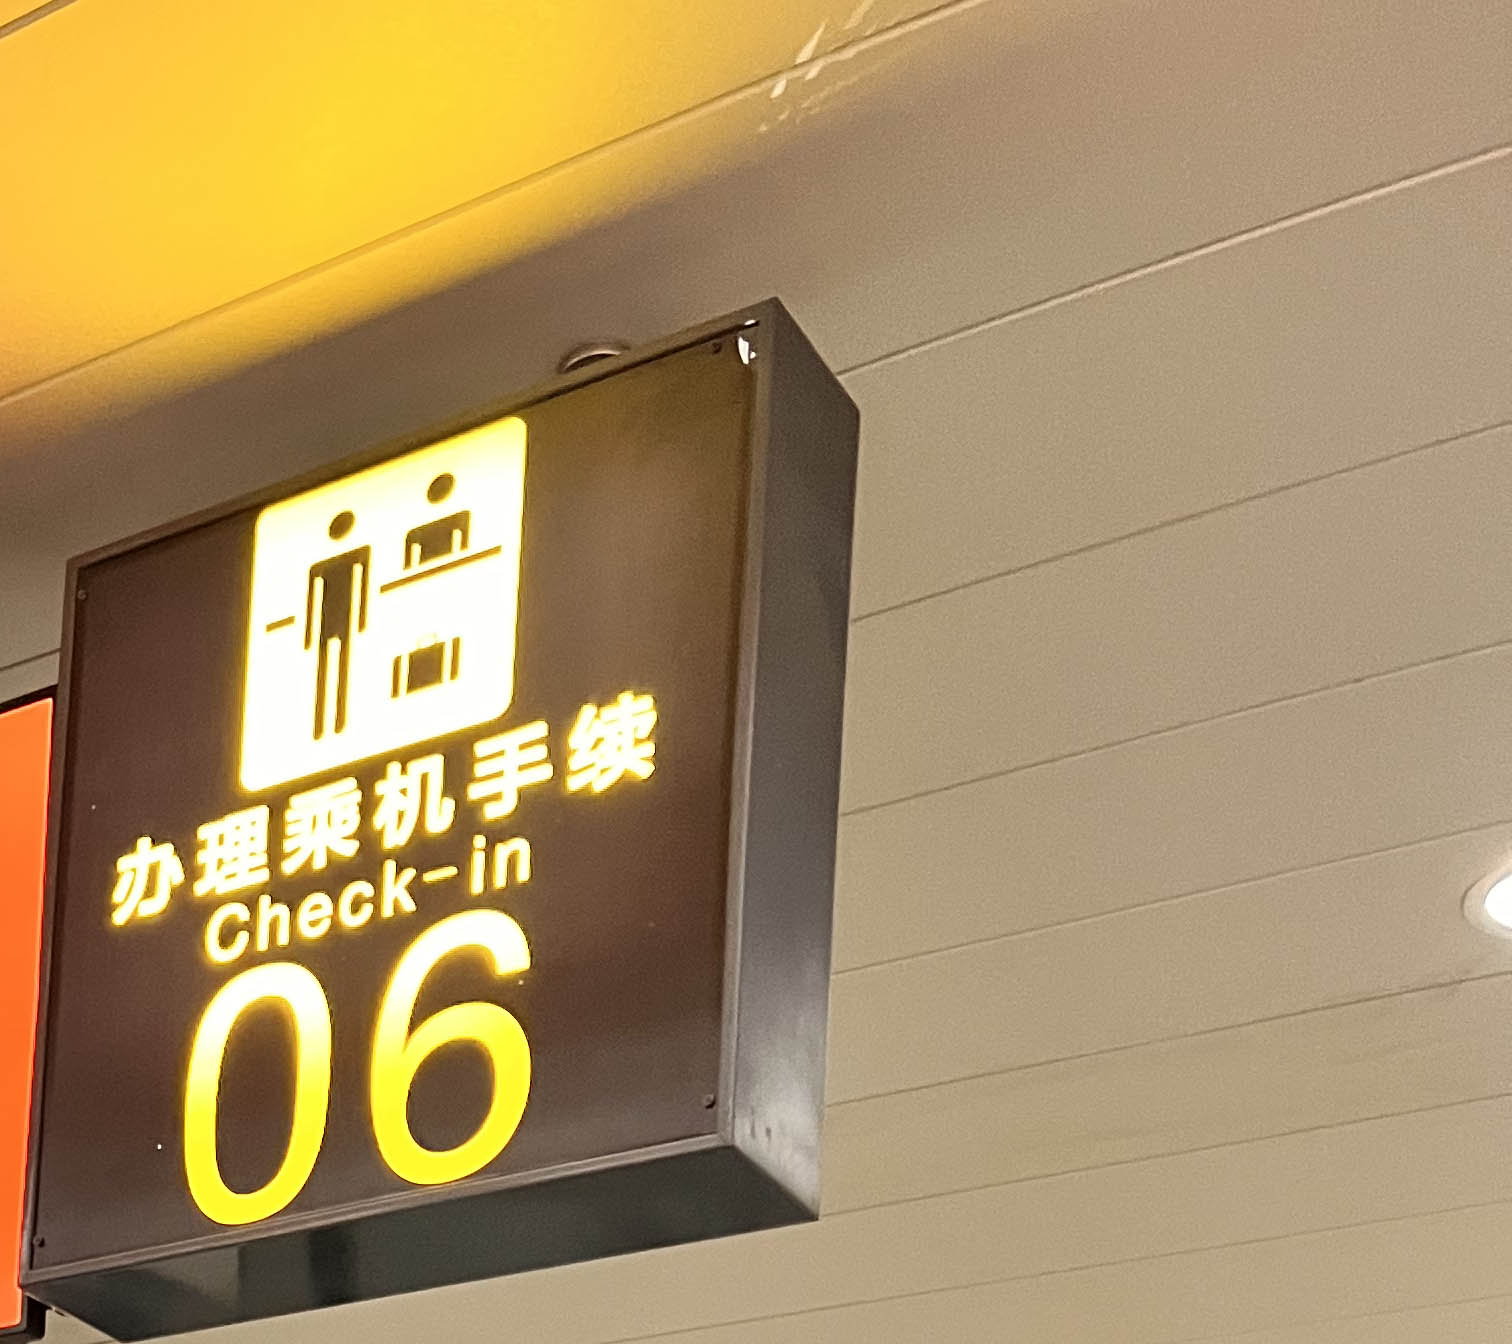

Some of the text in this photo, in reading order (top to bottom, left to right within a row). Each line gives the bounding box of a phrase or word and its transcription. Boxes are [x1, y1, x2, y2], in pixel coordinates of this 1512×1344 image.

[109, 690, 660, 928] 办理乘机手续
[205, 833, 532, 964] Check-in
[184, 908, 532, 1226] 06
